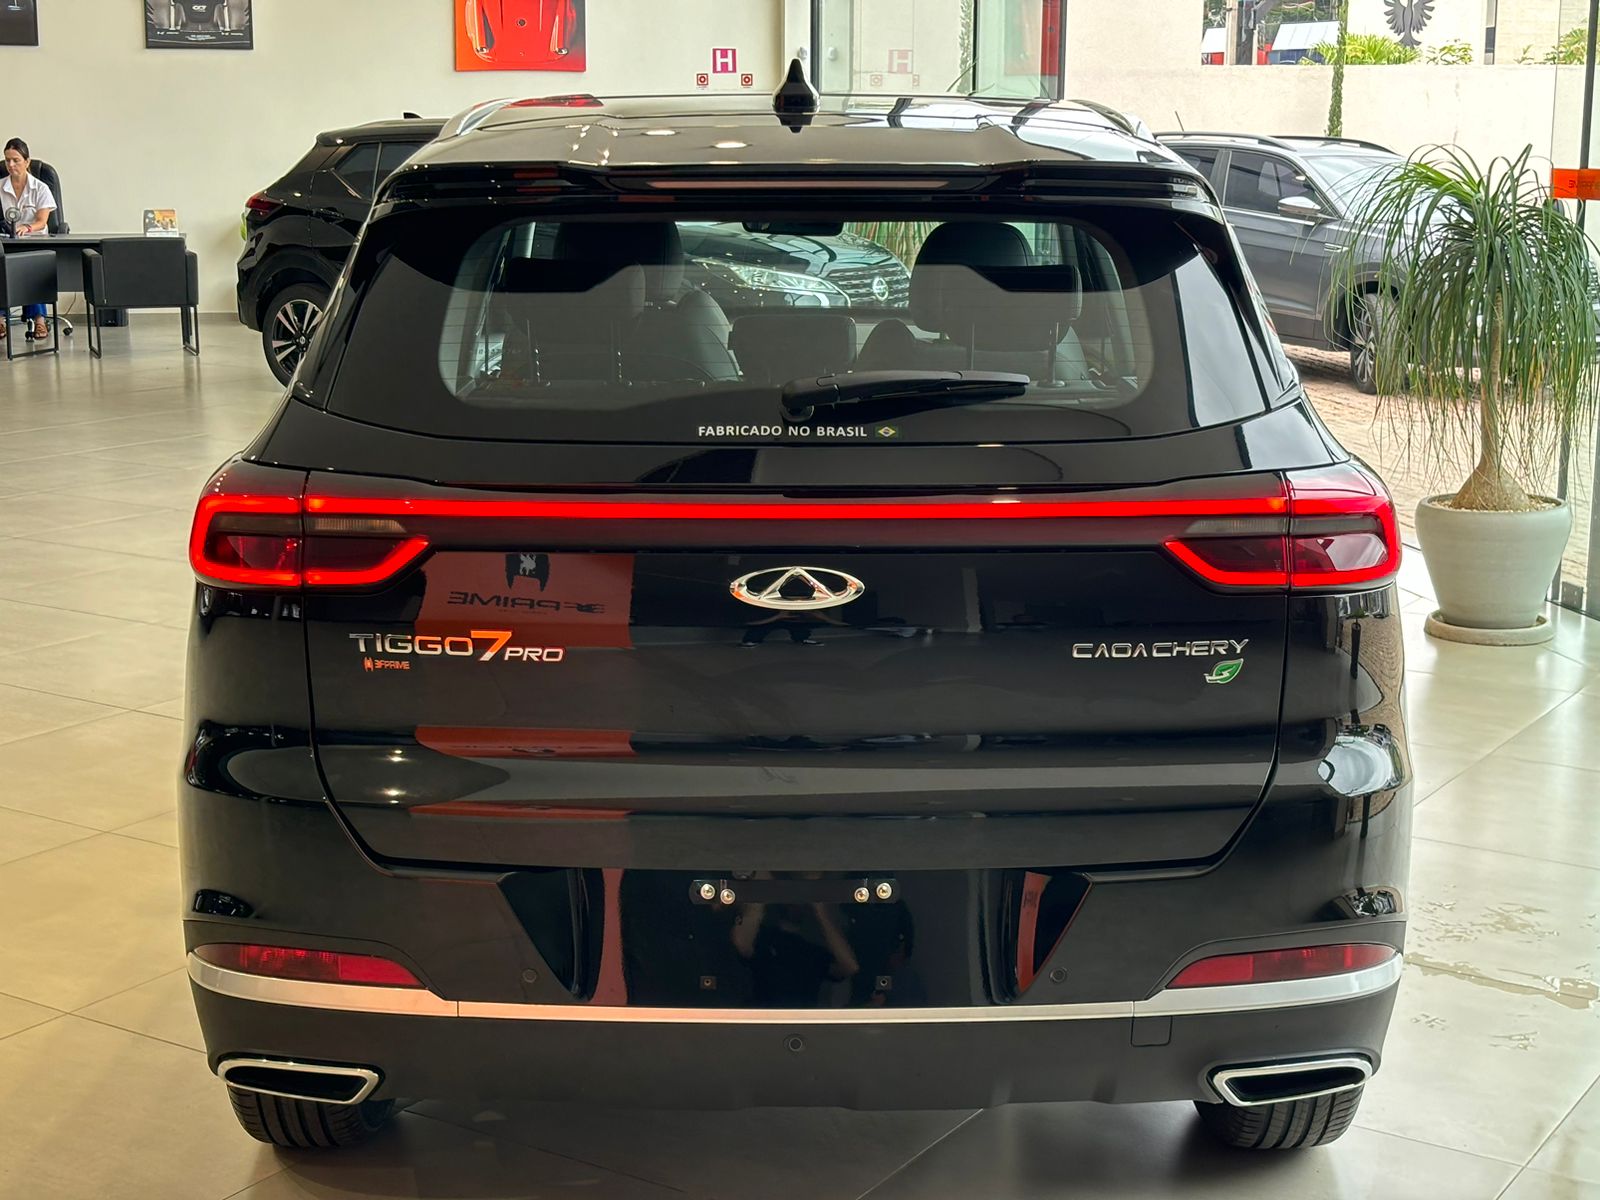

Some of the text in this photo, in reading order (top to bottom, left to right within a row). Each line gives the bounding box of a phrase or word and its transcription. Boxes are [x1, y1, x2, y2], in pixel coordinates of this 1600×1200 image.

[715, 49, 733, 72] H
[698, 425, 868, 437] FABRICADO NO BRASIL
[503, 647, 564, 662] PRO
[1151, 638, 1249, 657] CHERY
